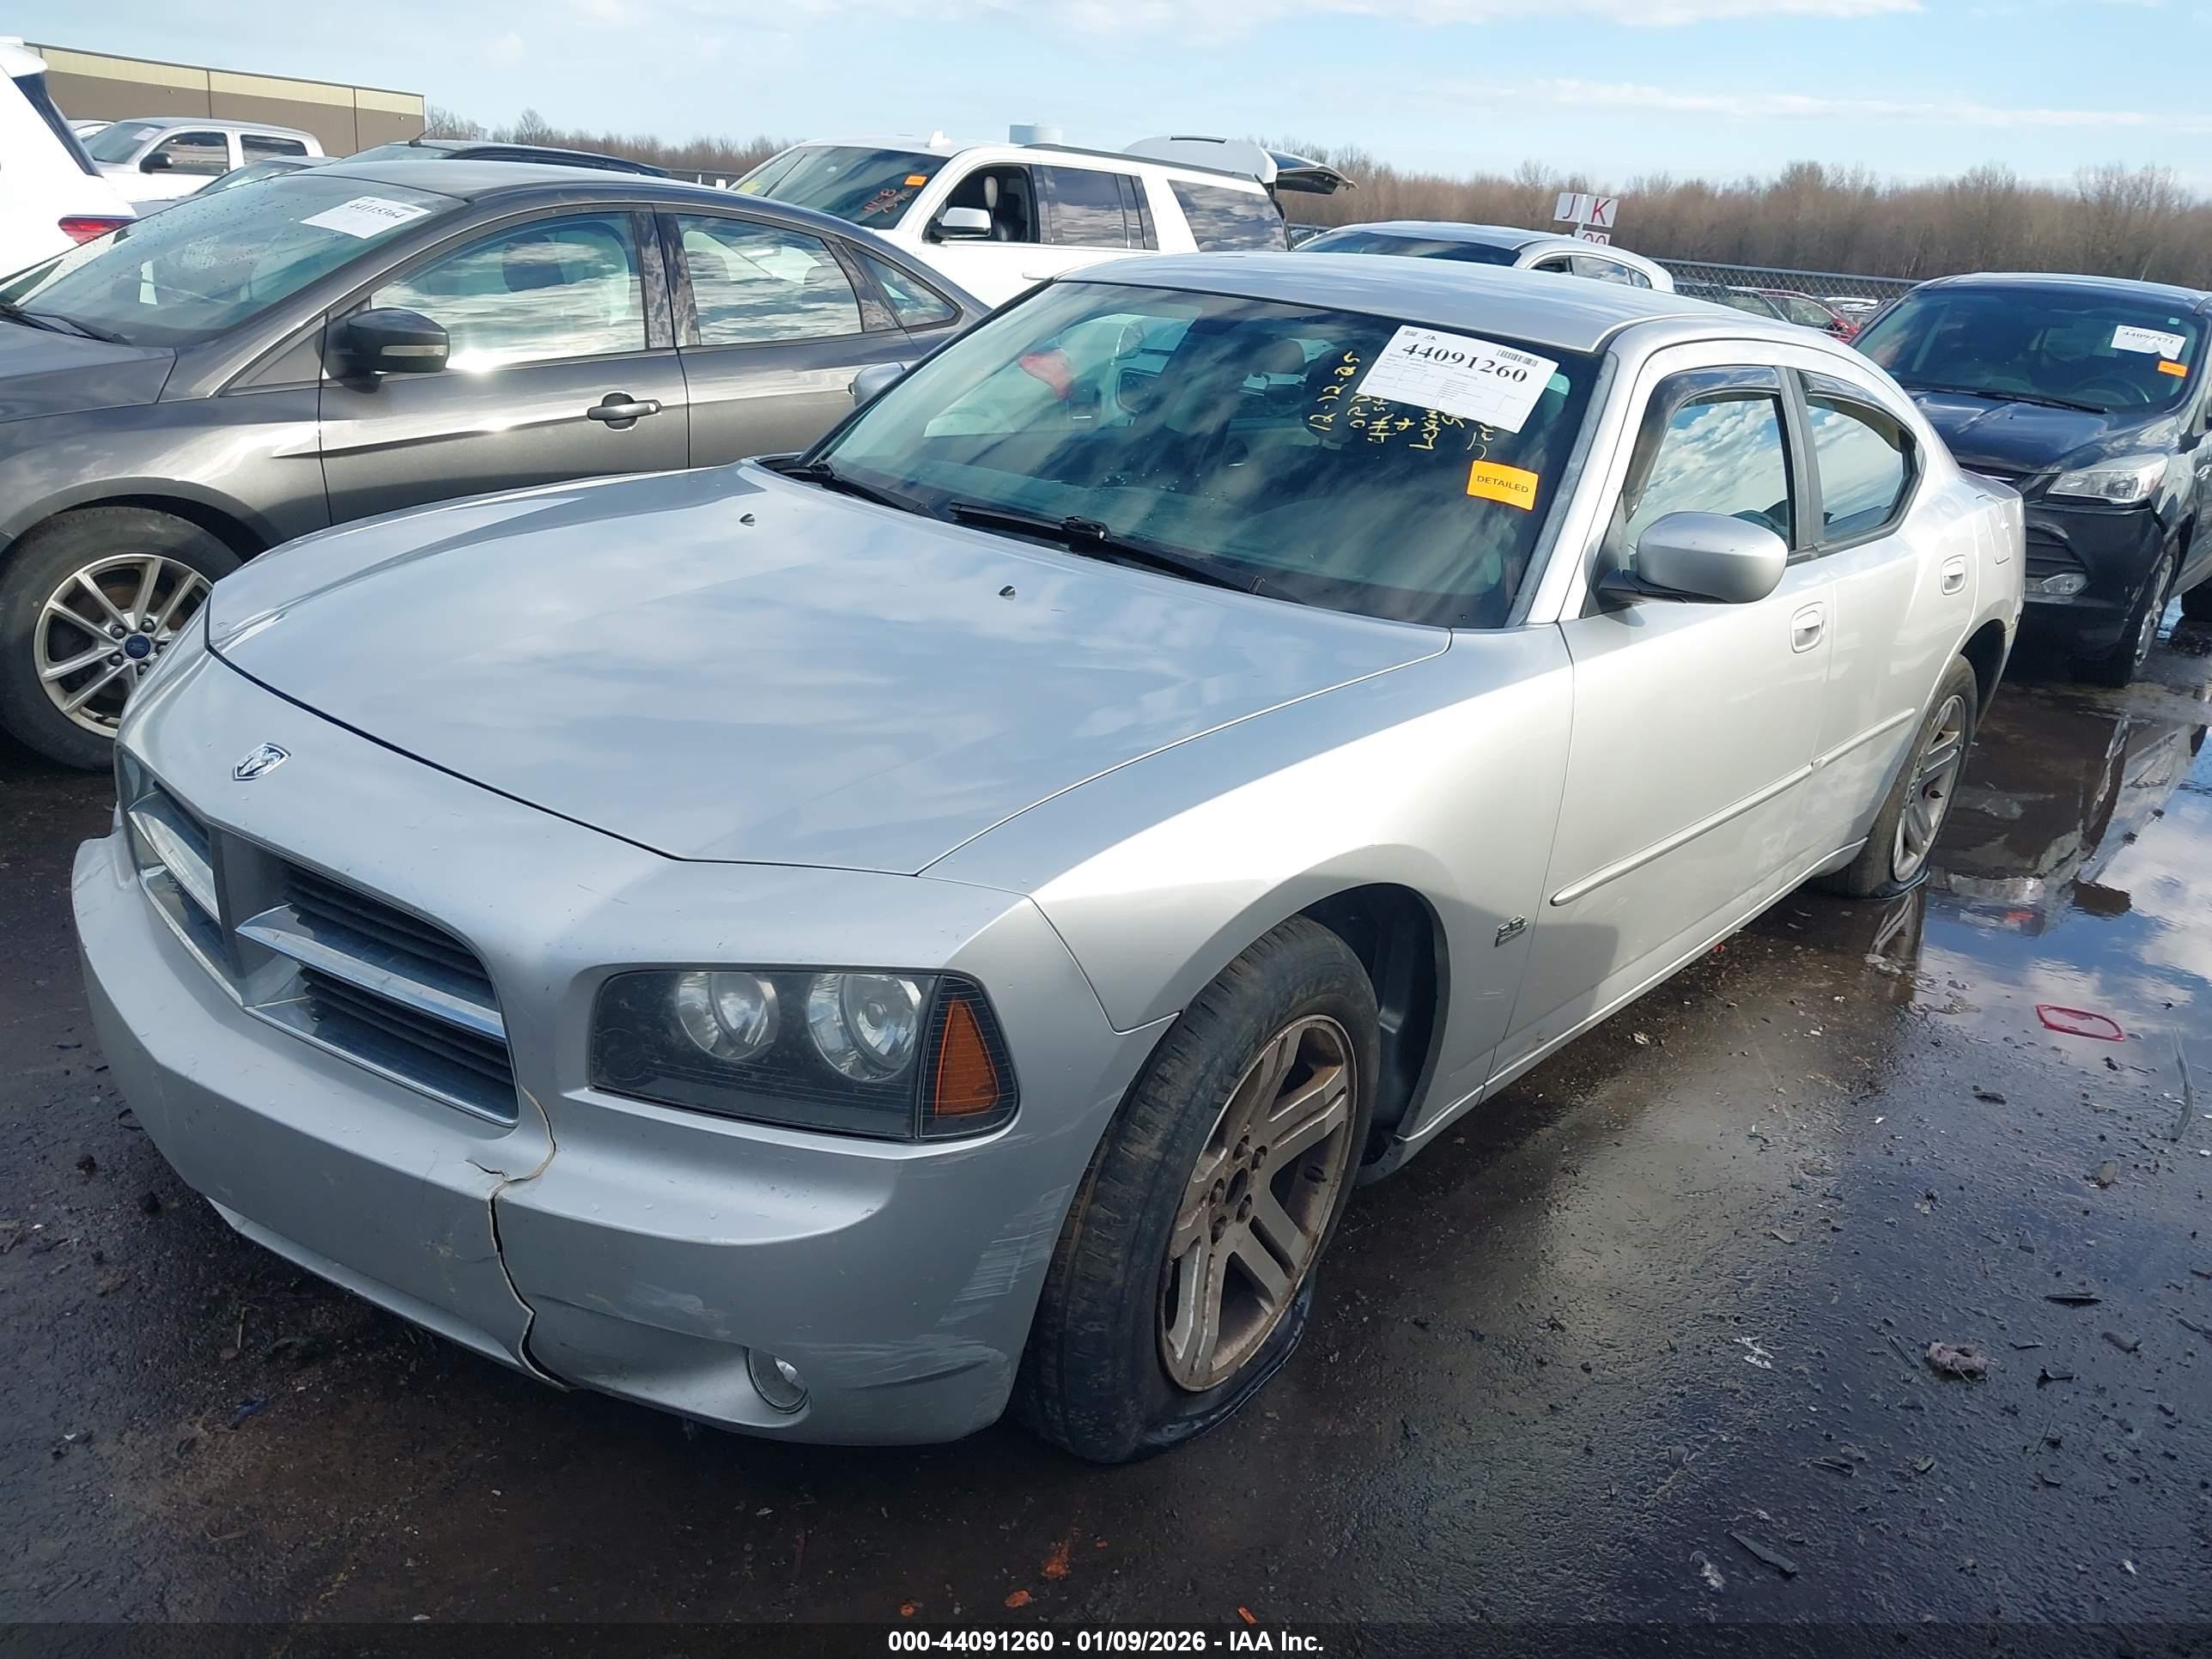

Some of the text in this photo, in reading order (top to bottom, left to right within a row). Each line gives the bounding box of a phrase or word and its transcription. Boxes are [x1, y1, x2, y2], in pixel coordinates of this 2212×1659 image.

[1562, 194, 1611, 225] J K
[1401, 342, 1528, 384] 44091260
[1477, 474, 1530, 495] DETAILED
